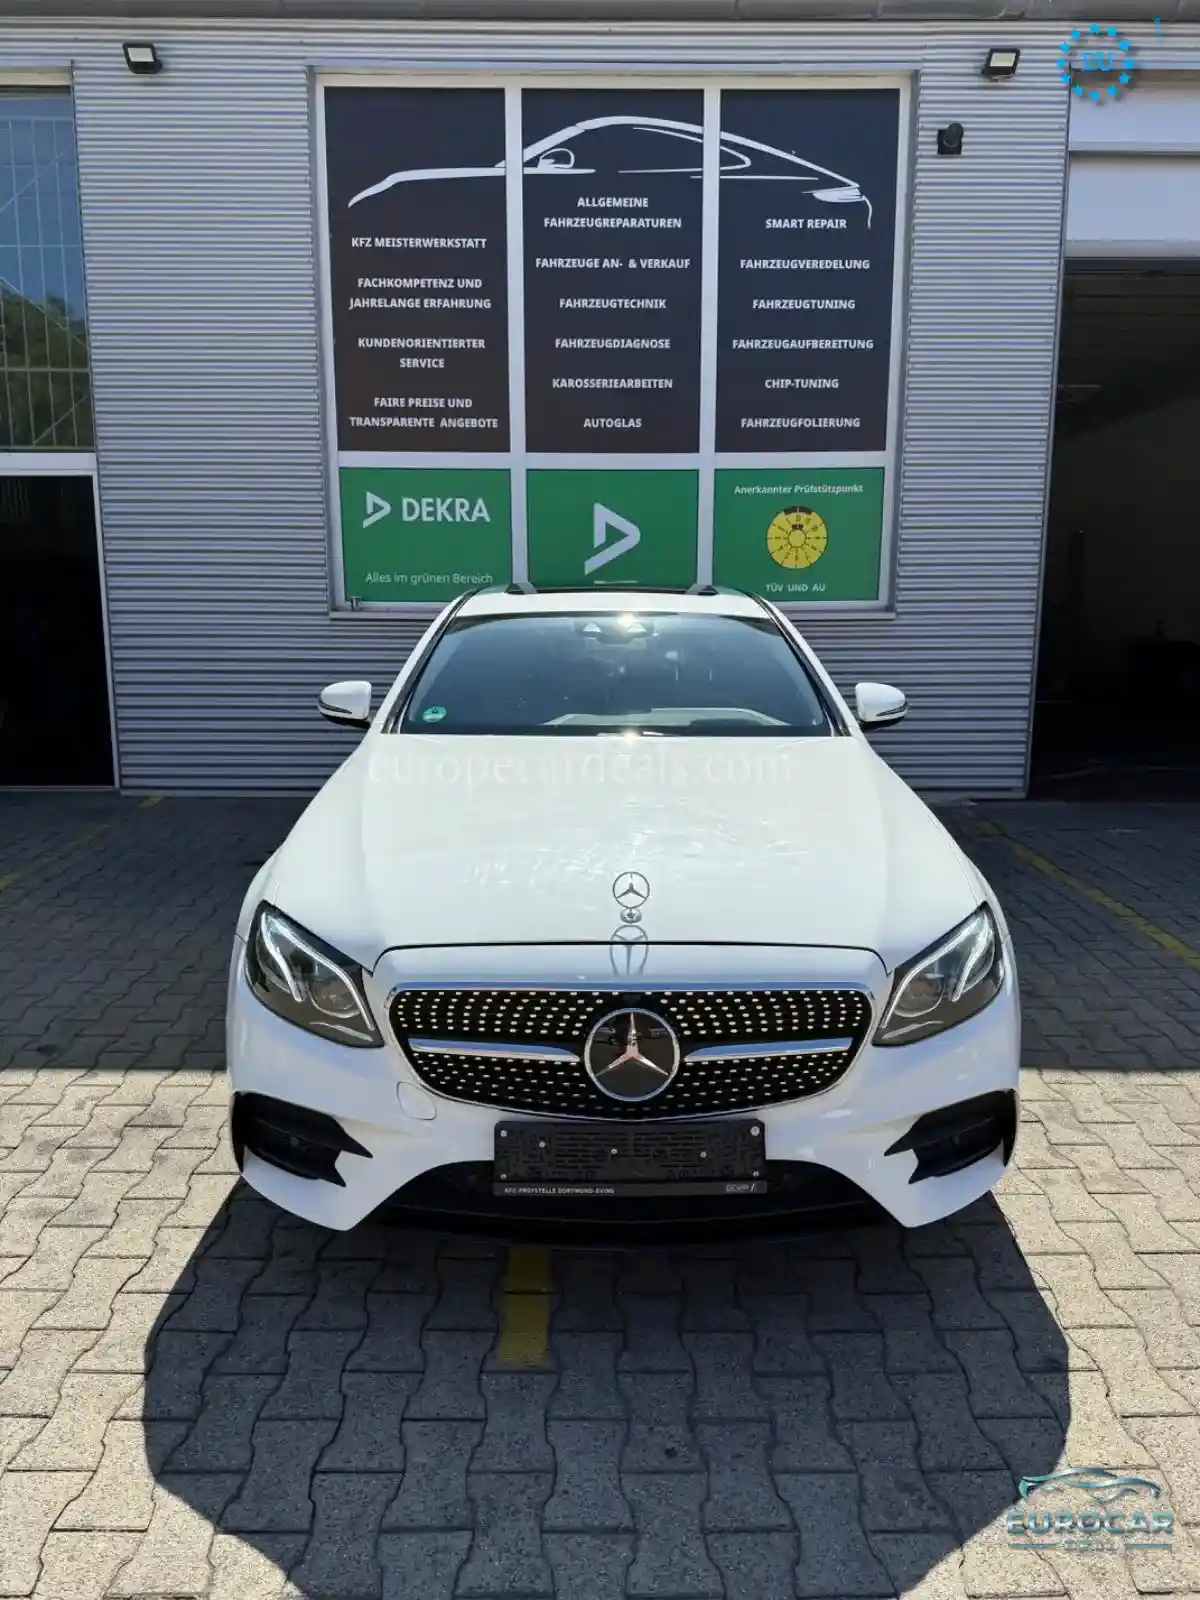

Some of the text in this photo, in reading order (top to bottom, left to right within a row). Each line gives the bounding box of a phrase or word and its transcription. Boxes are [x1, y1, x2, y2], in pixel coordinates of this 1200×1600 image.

[576, 196, 649, 208] ALLGEMEINE
[543, 217, 682, 229] FAHRZEUGREPARATUREN
[765, 218, 847, 229] SMART REPAIR
[351, 237, 487, 249] KFZ MEISTERWERKSTATT
[535, 257, 691, 269] FAHRZEUGE AN- & VERKAUF
[740, 259, 870, 270] FAHRZEUGVEREDELUNG
[357, 277, 483, 289] FACHKOMPETENZ UND
[348, 297, 492, 310] JAHRELANGE ERFAHRUNG
[559, 298, 667, 309] FAHRZEUGTECHNIK
[752, 299, 856, 310] FAHRZEUGTUNING
[358, 337, 486, 349] KUNDENORIENTIERTER
[555, 338, 671, 349] FAHRZEUGDIAGNOSE
[732, 339, 874, 350] FAHRZEUGAUFBEREITUNG
[399, 357, 445, 369] SERVICE
[552, 378, 673, 389] KAROSSERIEARBEITEN
[764, 378, 839, 389] CHIP-TUNING
[374, 397, 473, 408] FAIRE PREISE UND
[349, 417, 498, 428] TRANSPARENTE ANGEBOTE
[583, 417, 642, 429] AUTOGLAS
[740, 417, 861, 428] FAHRZEUGFOLIERUNG
[734, 484, 864, 496] Anerkannter Prüfstützpunkt
[402, 497, 491, 523] DEKRA
[365, 572, 493, 586] Alles im grünen Bereich
[765, 581, 826, 592] TÜV UND AU
